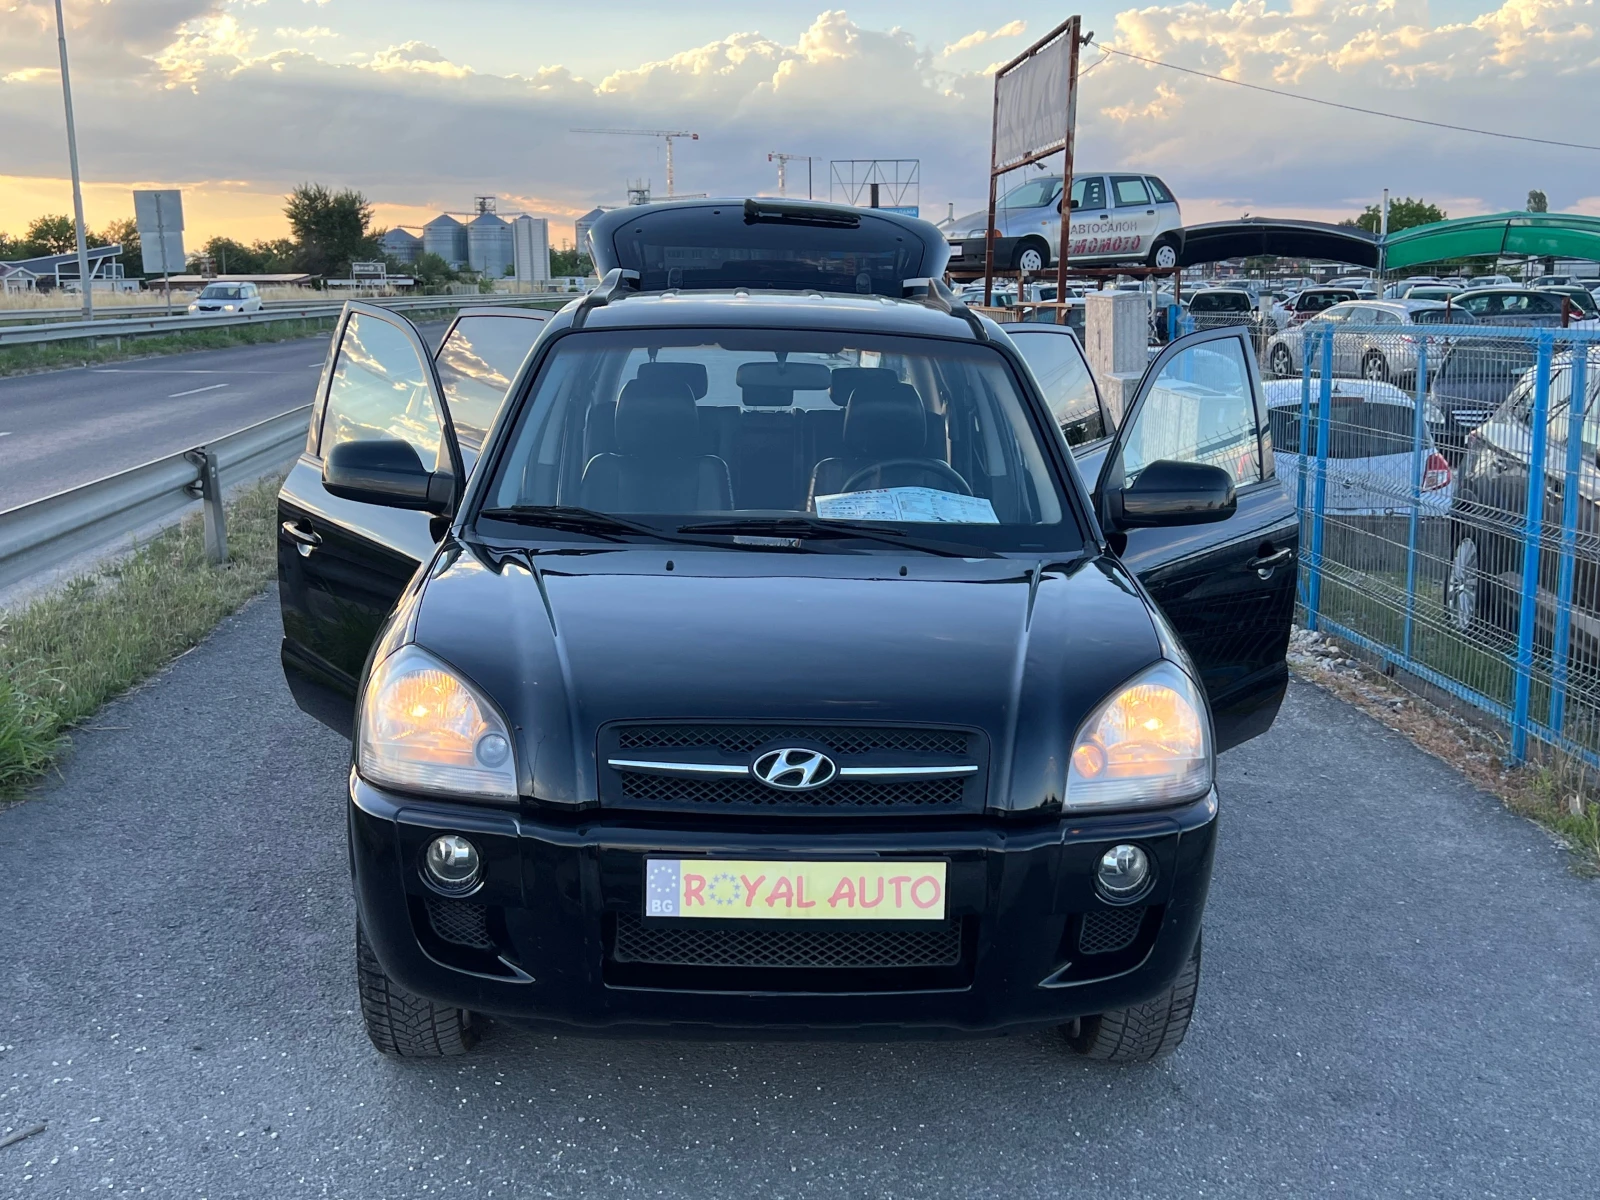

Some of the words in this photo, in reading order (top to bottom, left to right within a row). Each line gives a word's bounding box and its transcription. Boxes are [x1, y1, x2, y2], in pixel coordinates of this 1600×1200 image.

[1070, 221, 1138, 234] АВТОСАЛОН
[827, 875, 941, 909] AUTO
[651, 899, 673, 913] BG
